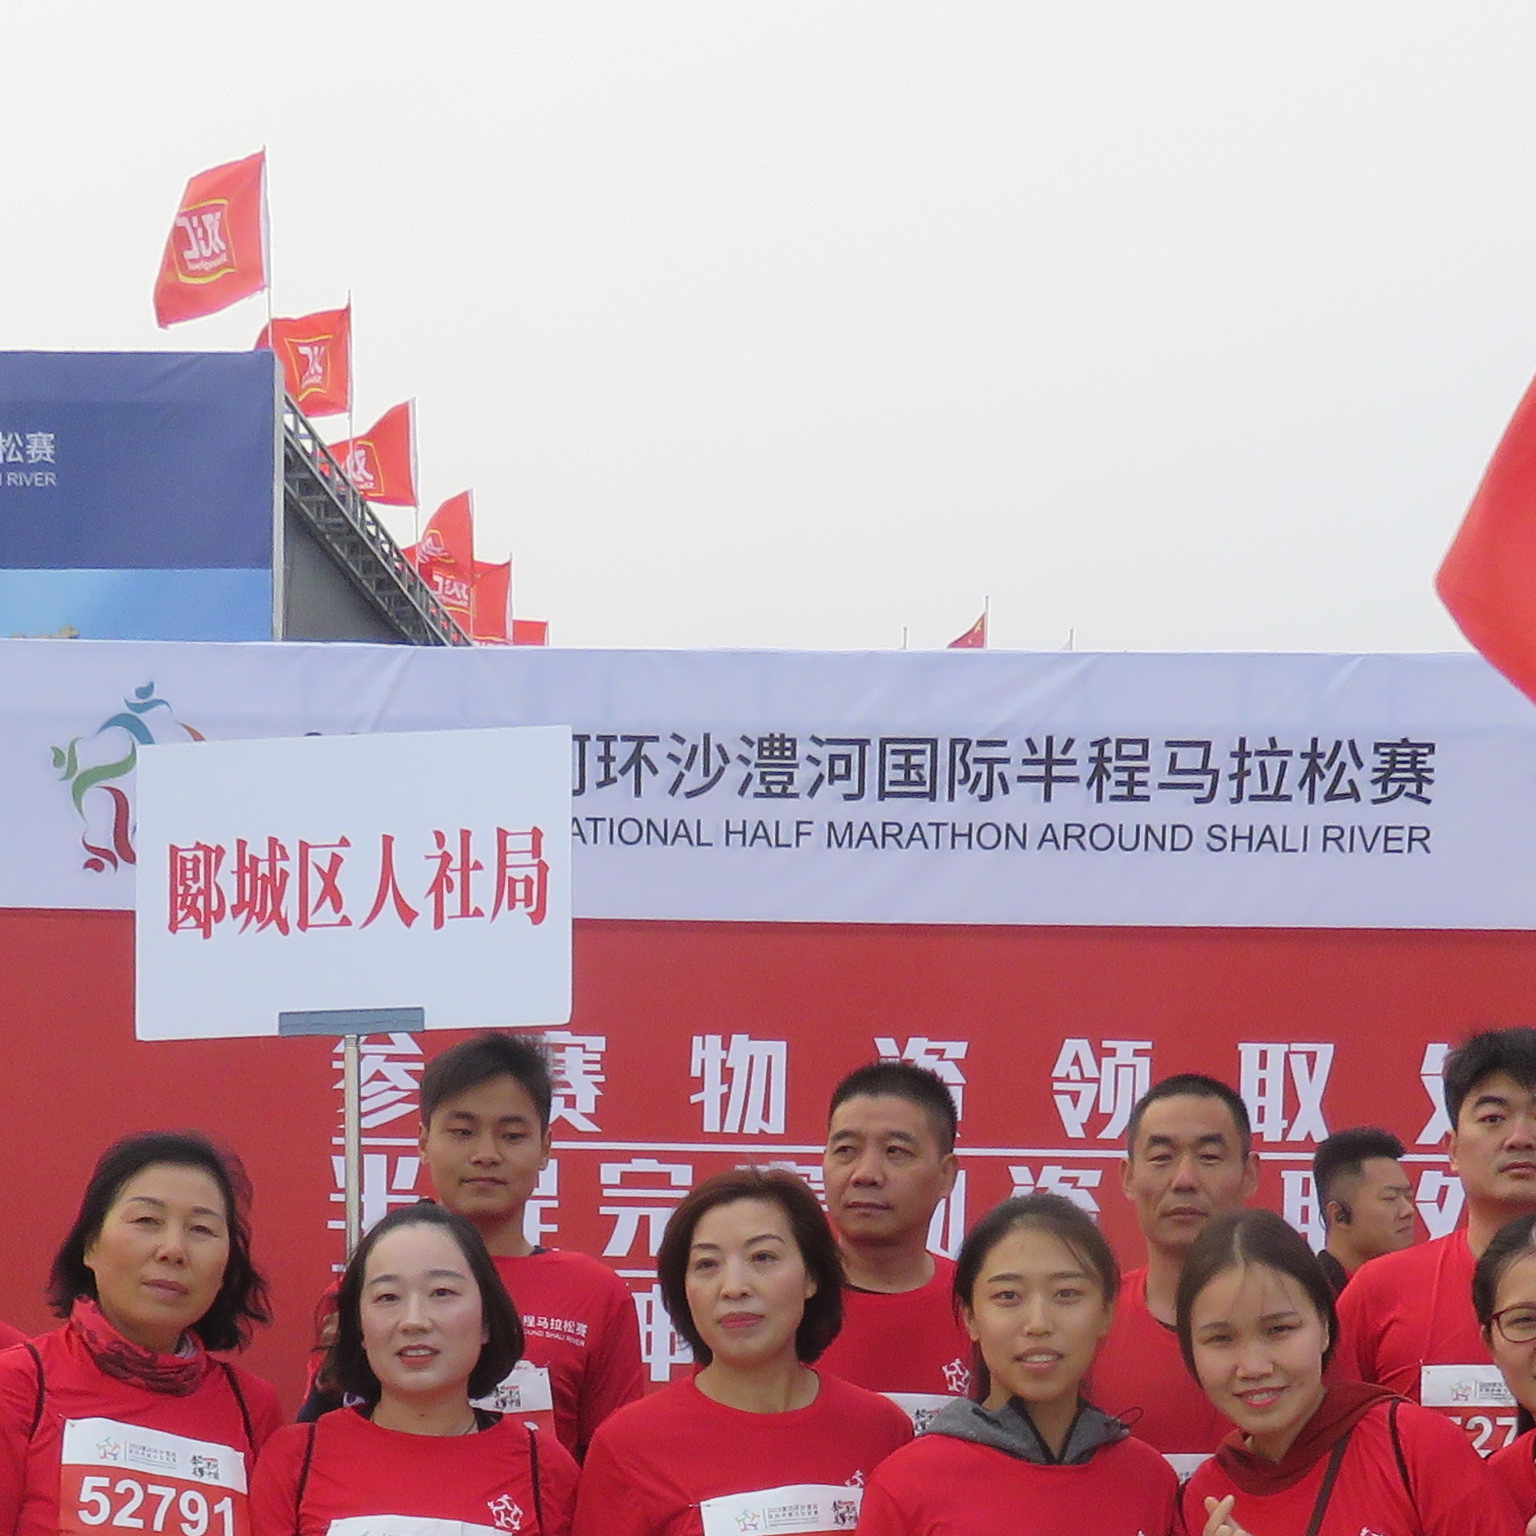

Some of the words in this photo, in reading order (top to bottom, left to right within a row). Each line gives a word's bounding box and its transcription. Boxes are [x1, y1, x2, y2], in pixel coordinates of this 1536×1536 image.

[8, 473, 56, 488] RIVER
[724, 819, 814, 849] HALF
[826, 821, 1028, 852] MARATHON
[1037, 823, 1194, 853] AROUND
[1205, 824, 1309, 854] SHALI
[1321, 825, 1432, 854] RIVER
[166, 826, 551, 940] 郾城区人社局
